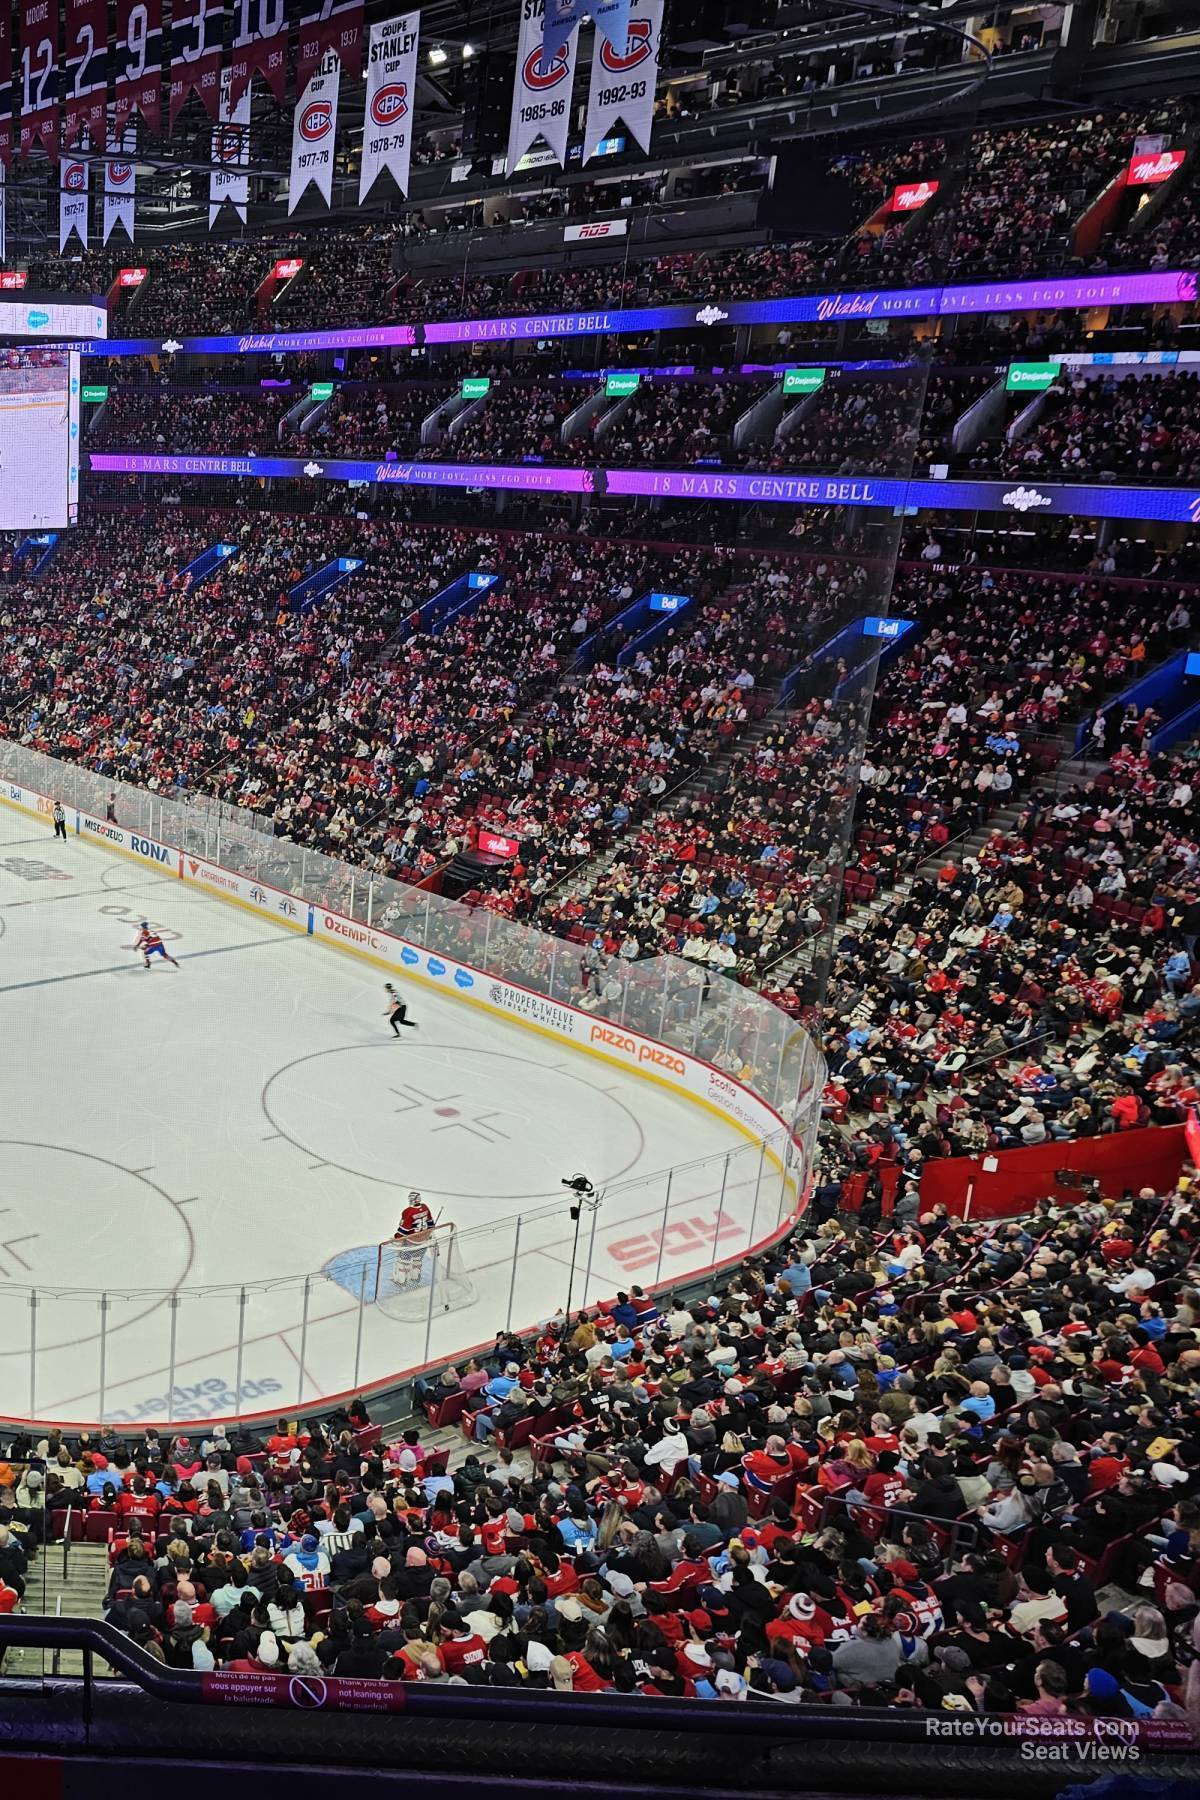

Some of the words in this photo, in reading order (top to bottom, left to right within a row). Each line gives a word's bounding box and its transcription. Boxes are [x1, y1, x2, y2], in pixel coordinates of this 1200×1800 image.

[25, 6, 49, 26] MOORE
[381, 20, 407, 37] COUPE
[126, 3, 148, 81] 9
[303, 41, 319, 59] 1923
[341, 28, 358, 47] 1937
[370, 31, 418, 63] STANLEY
[74, 23, 94, 99] 2
[385, 60, 401, 73] CUP
[21, 38, 53, 116] 12
[311, 80, 325, 92] CUP
[598, 80, 646, 107] 1992-93
[520, 99, 566, 123] 1985-86
[369, 134, 405, 154] 1978-79
[298, 150, 329, 168] 1977-78
[64, 202, 85, 217] 1972-73
[816, 294, 879, 320] Wizkid
[882, 298, 921, 311] MORE
[1076, 286, 1121, 299] TOUR
[457, 324, 471, 338] 18
[478, 322, 517, 337] MARS
[525, 318, 574, 333] CENTRE
[577, 315, 611, 331] BELL
[125, 459, 137, 469] 18
[144, 459, 178, 470] MARS
[185, 460, 227, 472] CENTRE
[231, 461, 252, 472] BELL
[376, 464, 414, 481] Wizkid
[653, 476, 671, 492] 18
[681, 478, 737, 494] MARS
[750, 480, 820, 498] CENTRE
[825, 483, 874, 501] BELL
[661, 597, 678, 609] Bell
[878, 620, 899, 635] Bell
[10, 786, 22, 802] Bell
[131, 835, 171, 865] RONA
[201, 869, 226, 888] CANADIAN
[227, 878, 239, 892] TIRE
[540, 1002, 574, 1027] TWELVE
[590, 1025, 636, 1055] pizza
[640, 1044, 686, 1076] pizza
[709, 1073, 737, 1097] Scotia
[215, 1672, 238, 1680] Merci
[339, 1679, 361, 1687] Thank
[224, 1694, 232, 1702] la
[230, 1685, 262, 1694] appuyer
[339, 1689, 352, 1697] not
[353, 1690, 381, 1700] leaning
